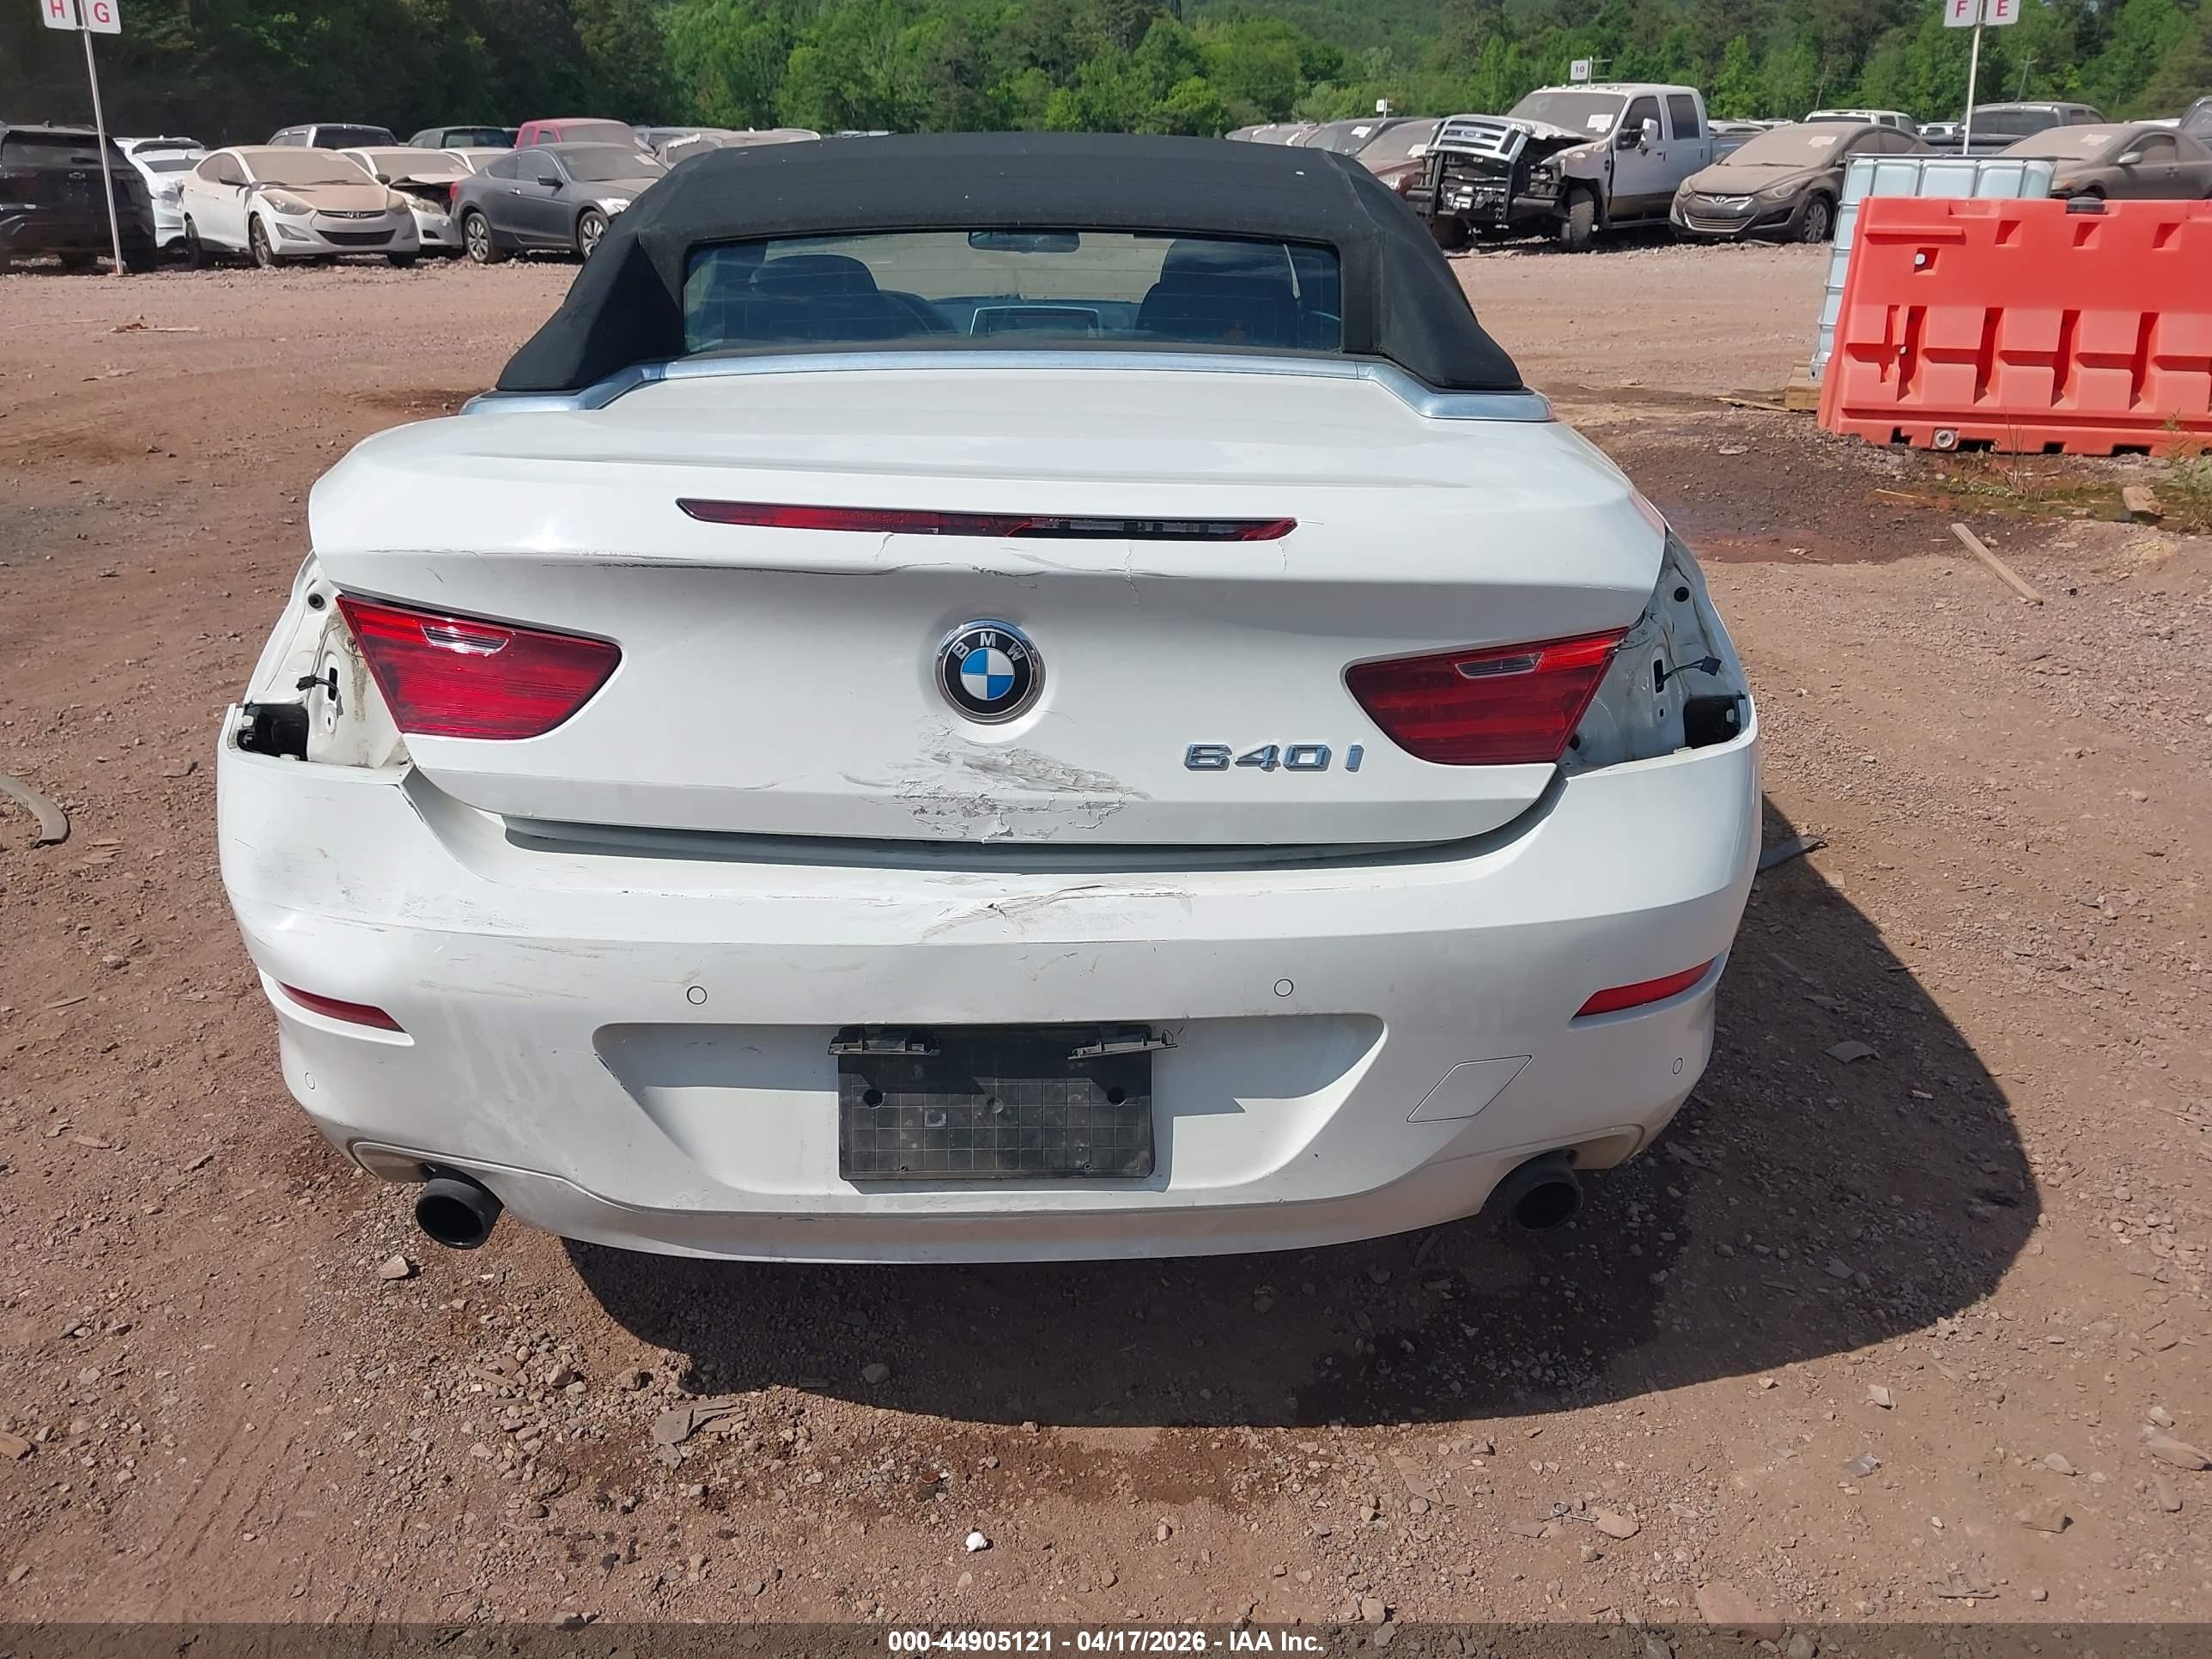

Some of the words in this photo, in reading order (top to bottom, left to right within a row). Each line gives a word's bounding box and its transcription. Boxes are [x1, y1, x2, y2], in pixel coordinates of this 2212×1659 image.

[50, 0, 65, 18] H
[94, 2, 110, 23] G
[1956, 0, 1968, 17] F
[1996, 0, 2008, 16] E
[952, 632, 1025, 661] BMW
